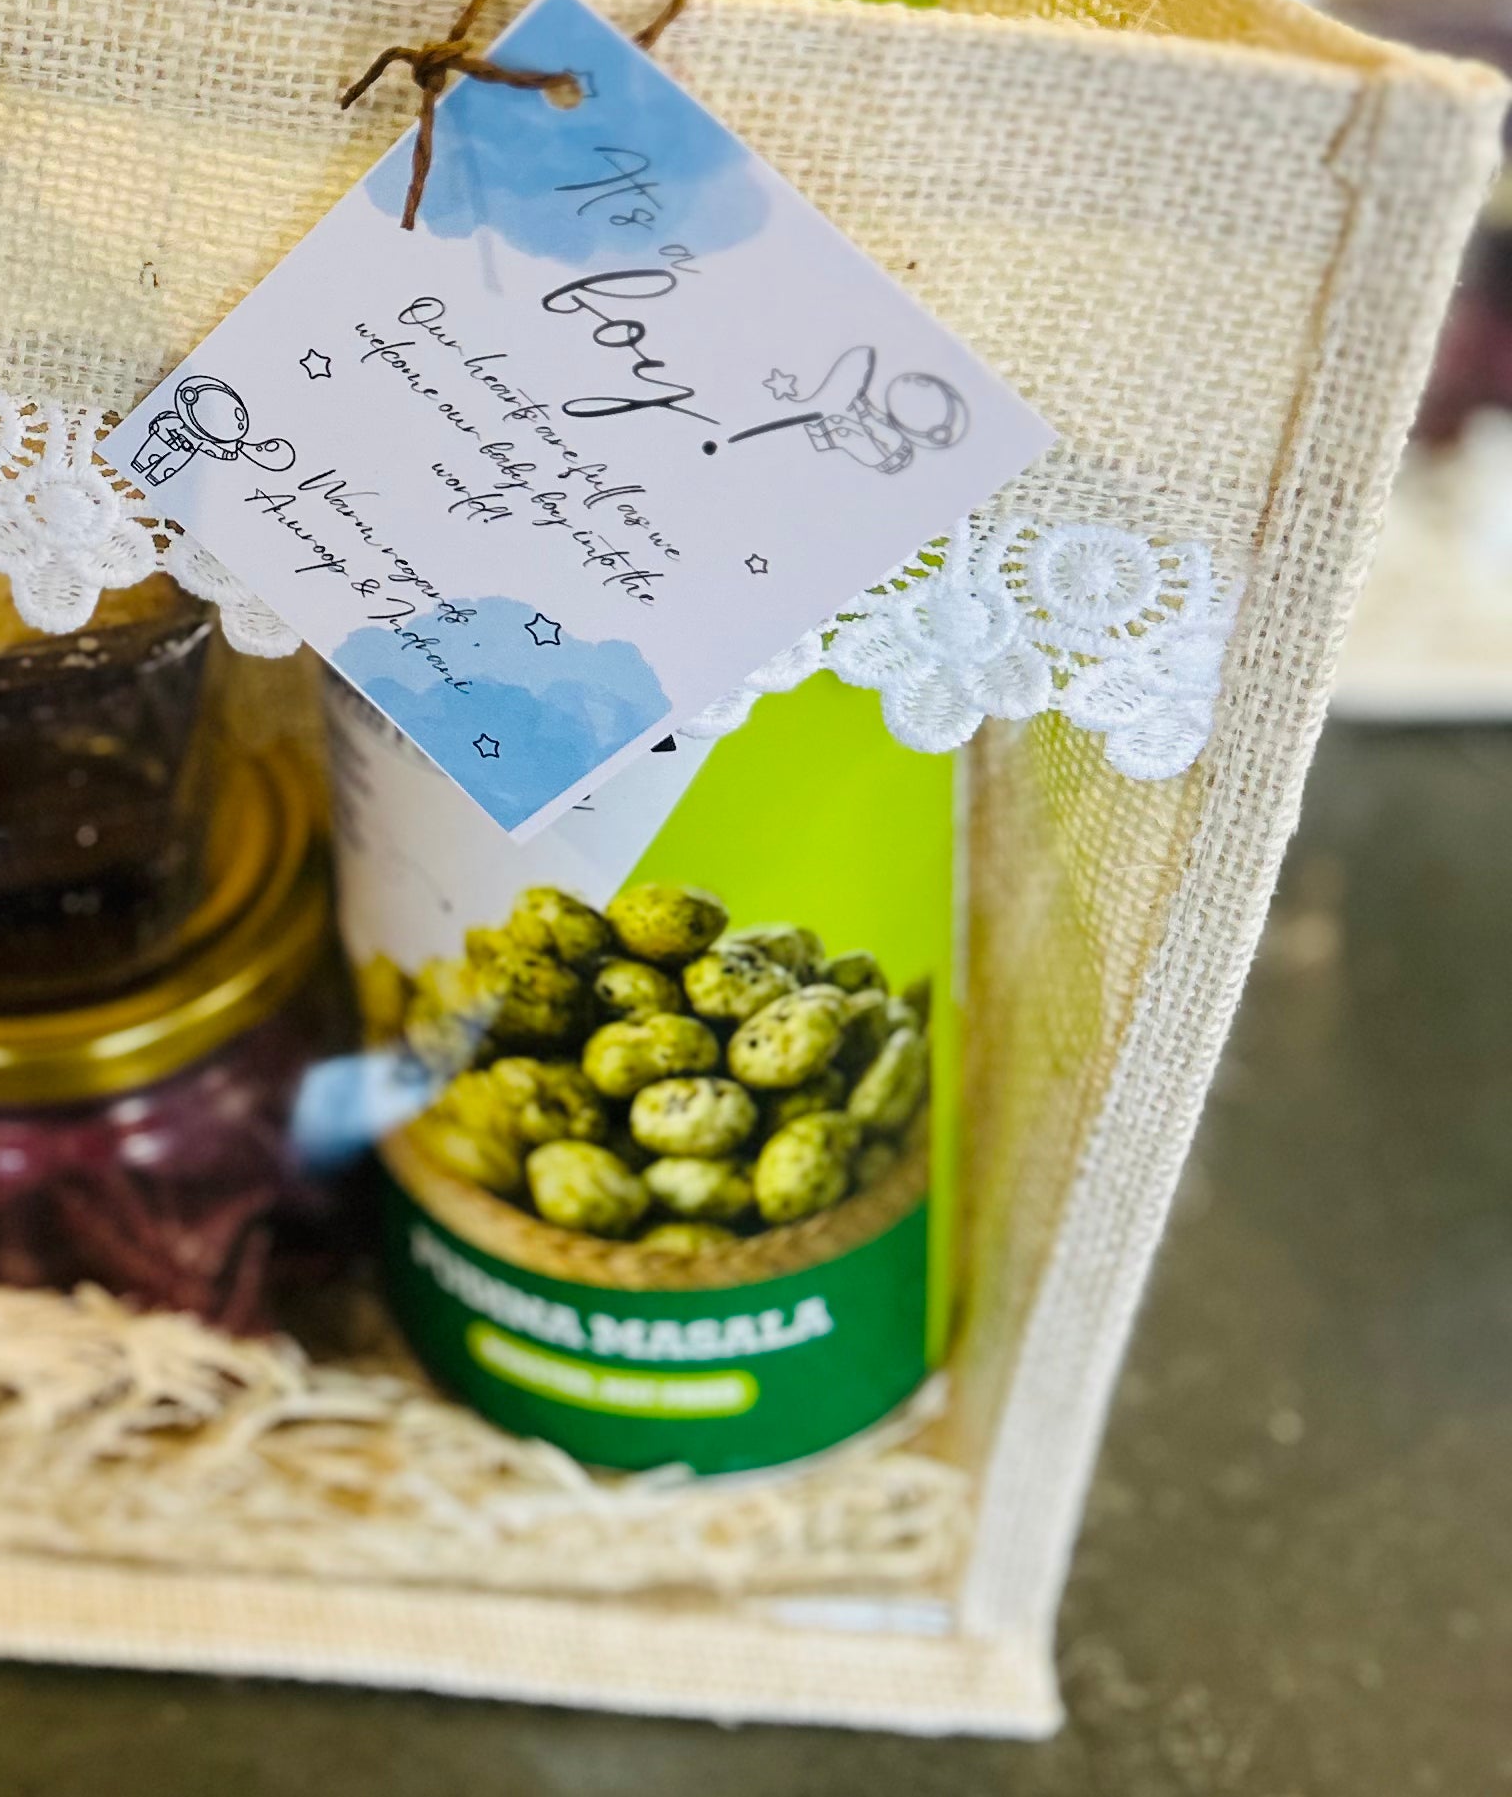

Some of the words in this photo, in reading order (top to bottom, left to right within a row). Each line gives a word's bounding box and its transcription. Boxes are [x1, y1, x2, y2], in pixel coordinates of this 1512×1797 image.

[657, 244, 701, 274] a
[355, 322, 438, 401] welcome
[438, 403, 482, 440] our
[480, 442, 536, 492] baby
[531, 491, 572, 528] boy
[572, 530, 630, 569] into
[602, 571, 664, 606] the
[398, 296, 464, 356] Our
[464, 353, 550, 422] hearts
[535, 426, 579, 463] are
[557, 463, 646, 508] full
[617, 503, 650, 531] as
[649, 531, 682, 562] we
[298, 469, 381, 546] Warm
[431, 462, 513, 523] world!
[244, 487, 349, 577] Anuroop
[350, 578, 381, 598] &
[587, 1296, 834, 1362] MASALA
